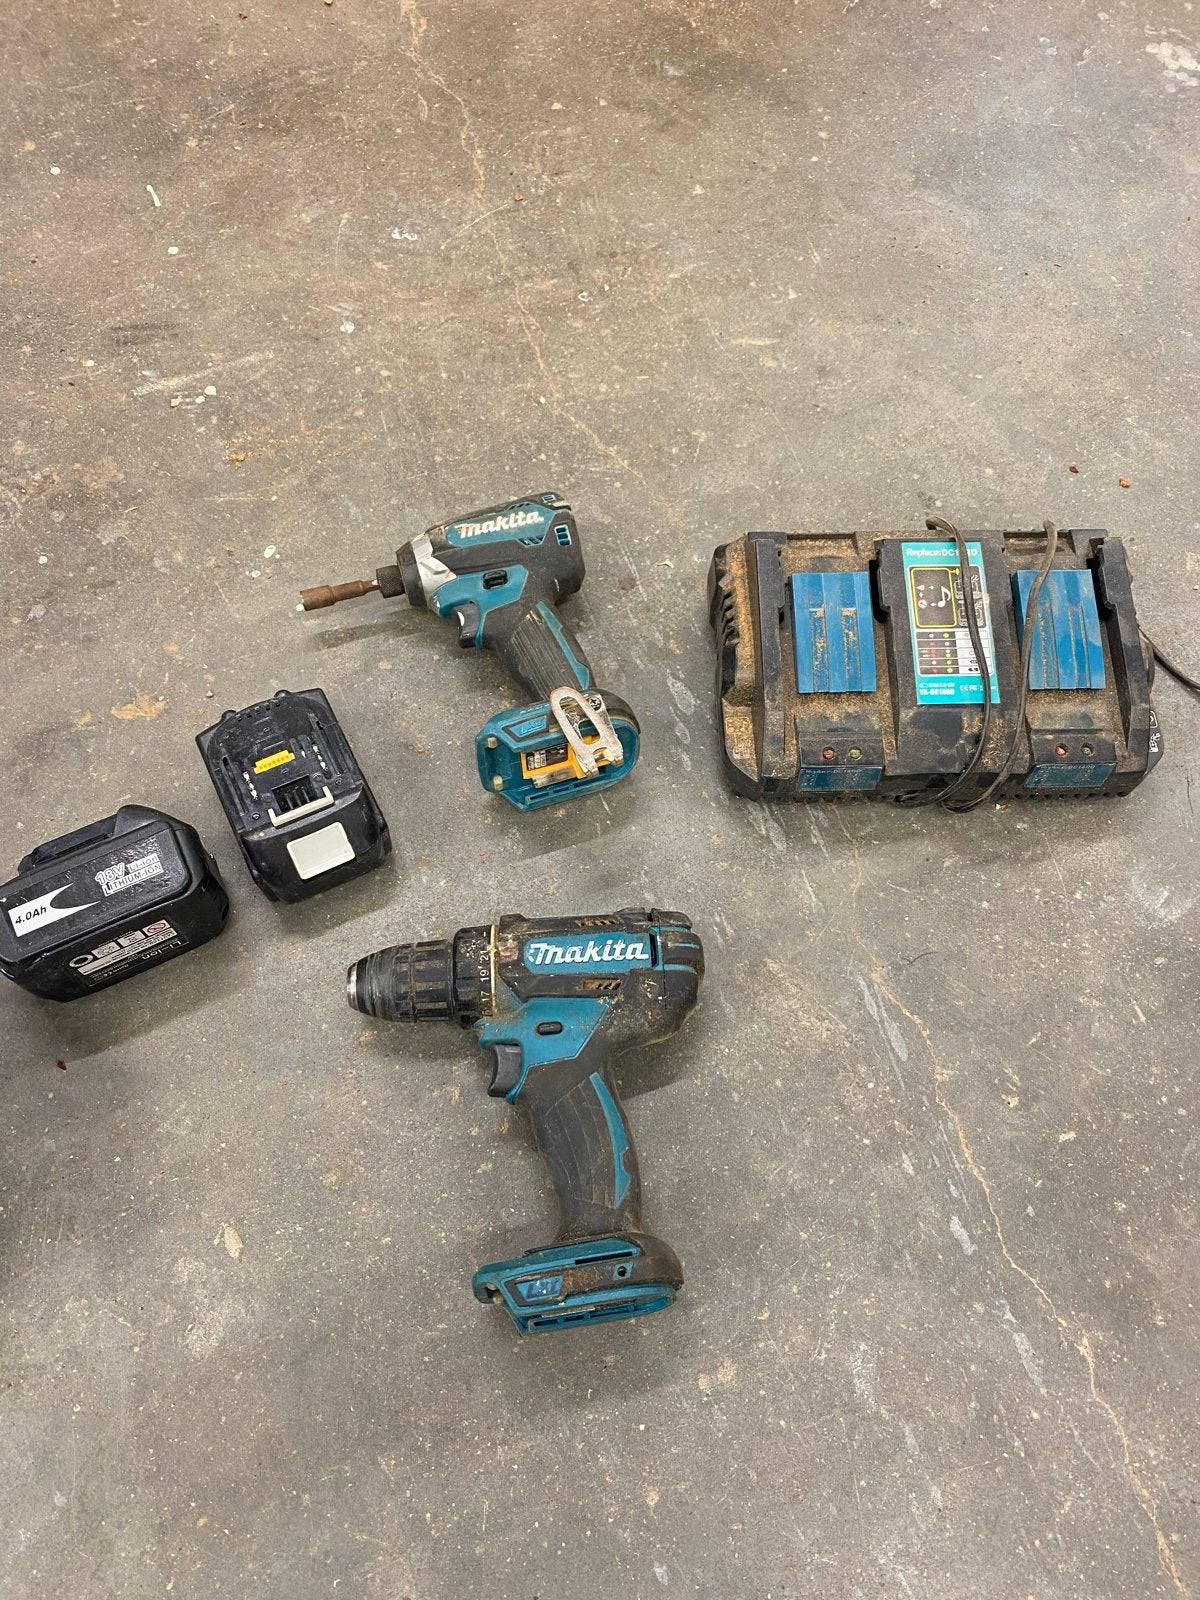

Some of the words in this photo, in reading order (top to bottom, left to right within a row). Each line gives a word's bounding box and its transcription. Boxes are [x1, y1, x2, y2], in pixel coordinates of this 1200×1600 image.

[95, 862, 125, 886] 18V
[15, 906, 47, 925] 4.0Ah
[480, 969, 490, 983] 19
[481, 990, 490, 1002] 17
